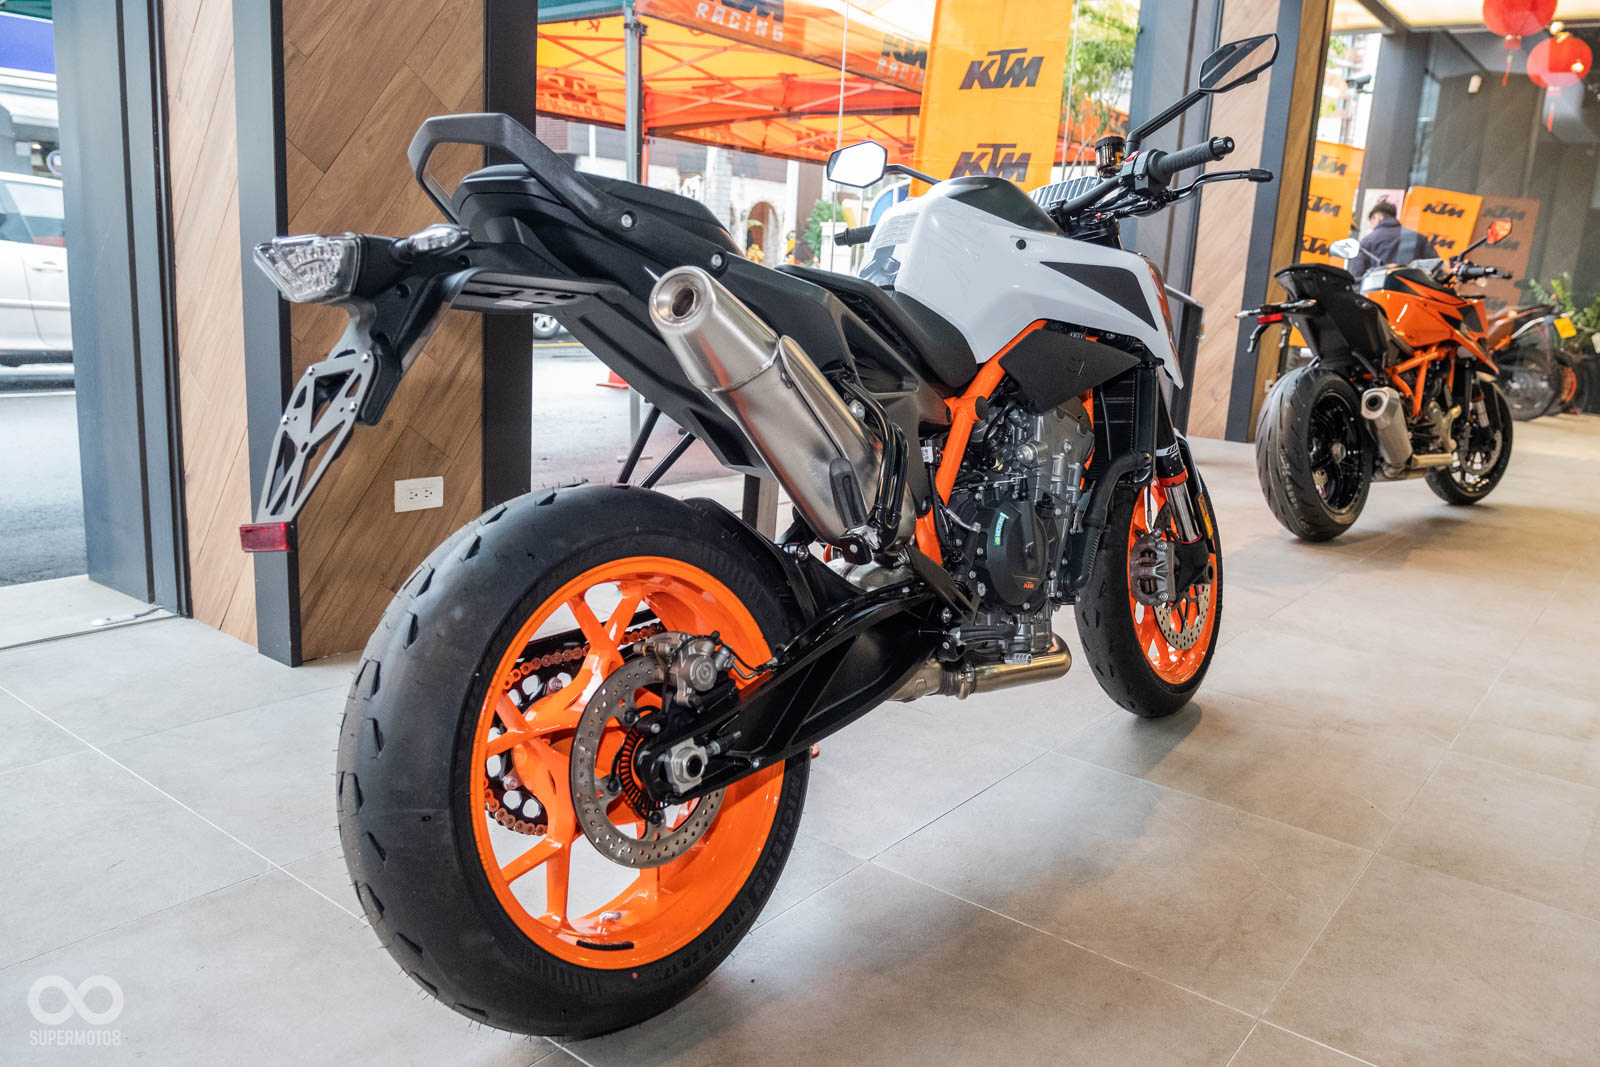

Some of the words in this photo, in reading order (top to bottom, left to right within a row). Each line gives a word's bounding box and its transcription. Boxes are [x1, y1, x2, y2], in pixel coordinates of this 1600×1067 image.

[958, 48, 1044, 90] KTM
[950, 143, 1032, 182] KTM
[1312, 153, 1348, 176] TM
[1422, 202, 1465, 218] KTM
[1430, 234, 1456, 249] TM
